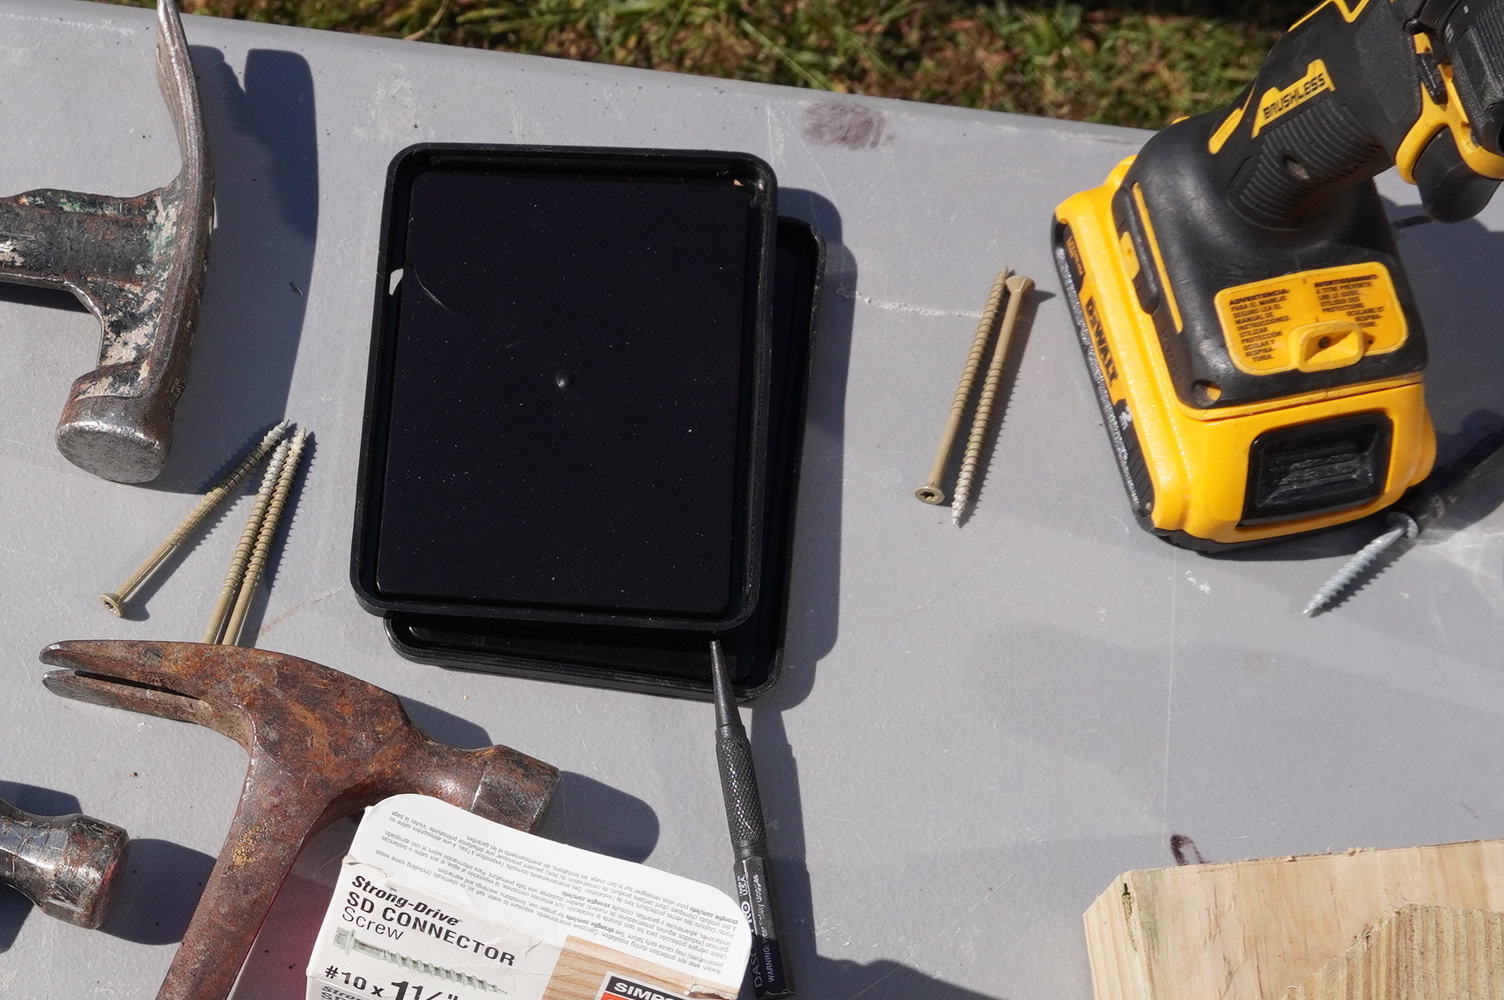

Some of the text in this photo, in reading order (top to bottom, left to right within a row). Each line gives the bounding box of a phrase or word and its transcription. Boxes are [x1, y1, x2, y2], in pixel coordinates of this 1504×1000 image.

[1262, 72, 1327, 121] BRUSHLESS
[432, 872, 458, 885] chemicals
[473, 881, 498, 894] warnings
[352, 875, 459, 926] Strong-Drive
[342, 907, 404, 940] Screw
[347, 891, 516, 966] SD CONNECTOR
[629, 940, 648, 951] during
[648, 946, 676, 961] protection
[762, 944, 775, 982] WARNING:
[325, 965, 367, 991] #10
[371, 985, 385, 997] x
